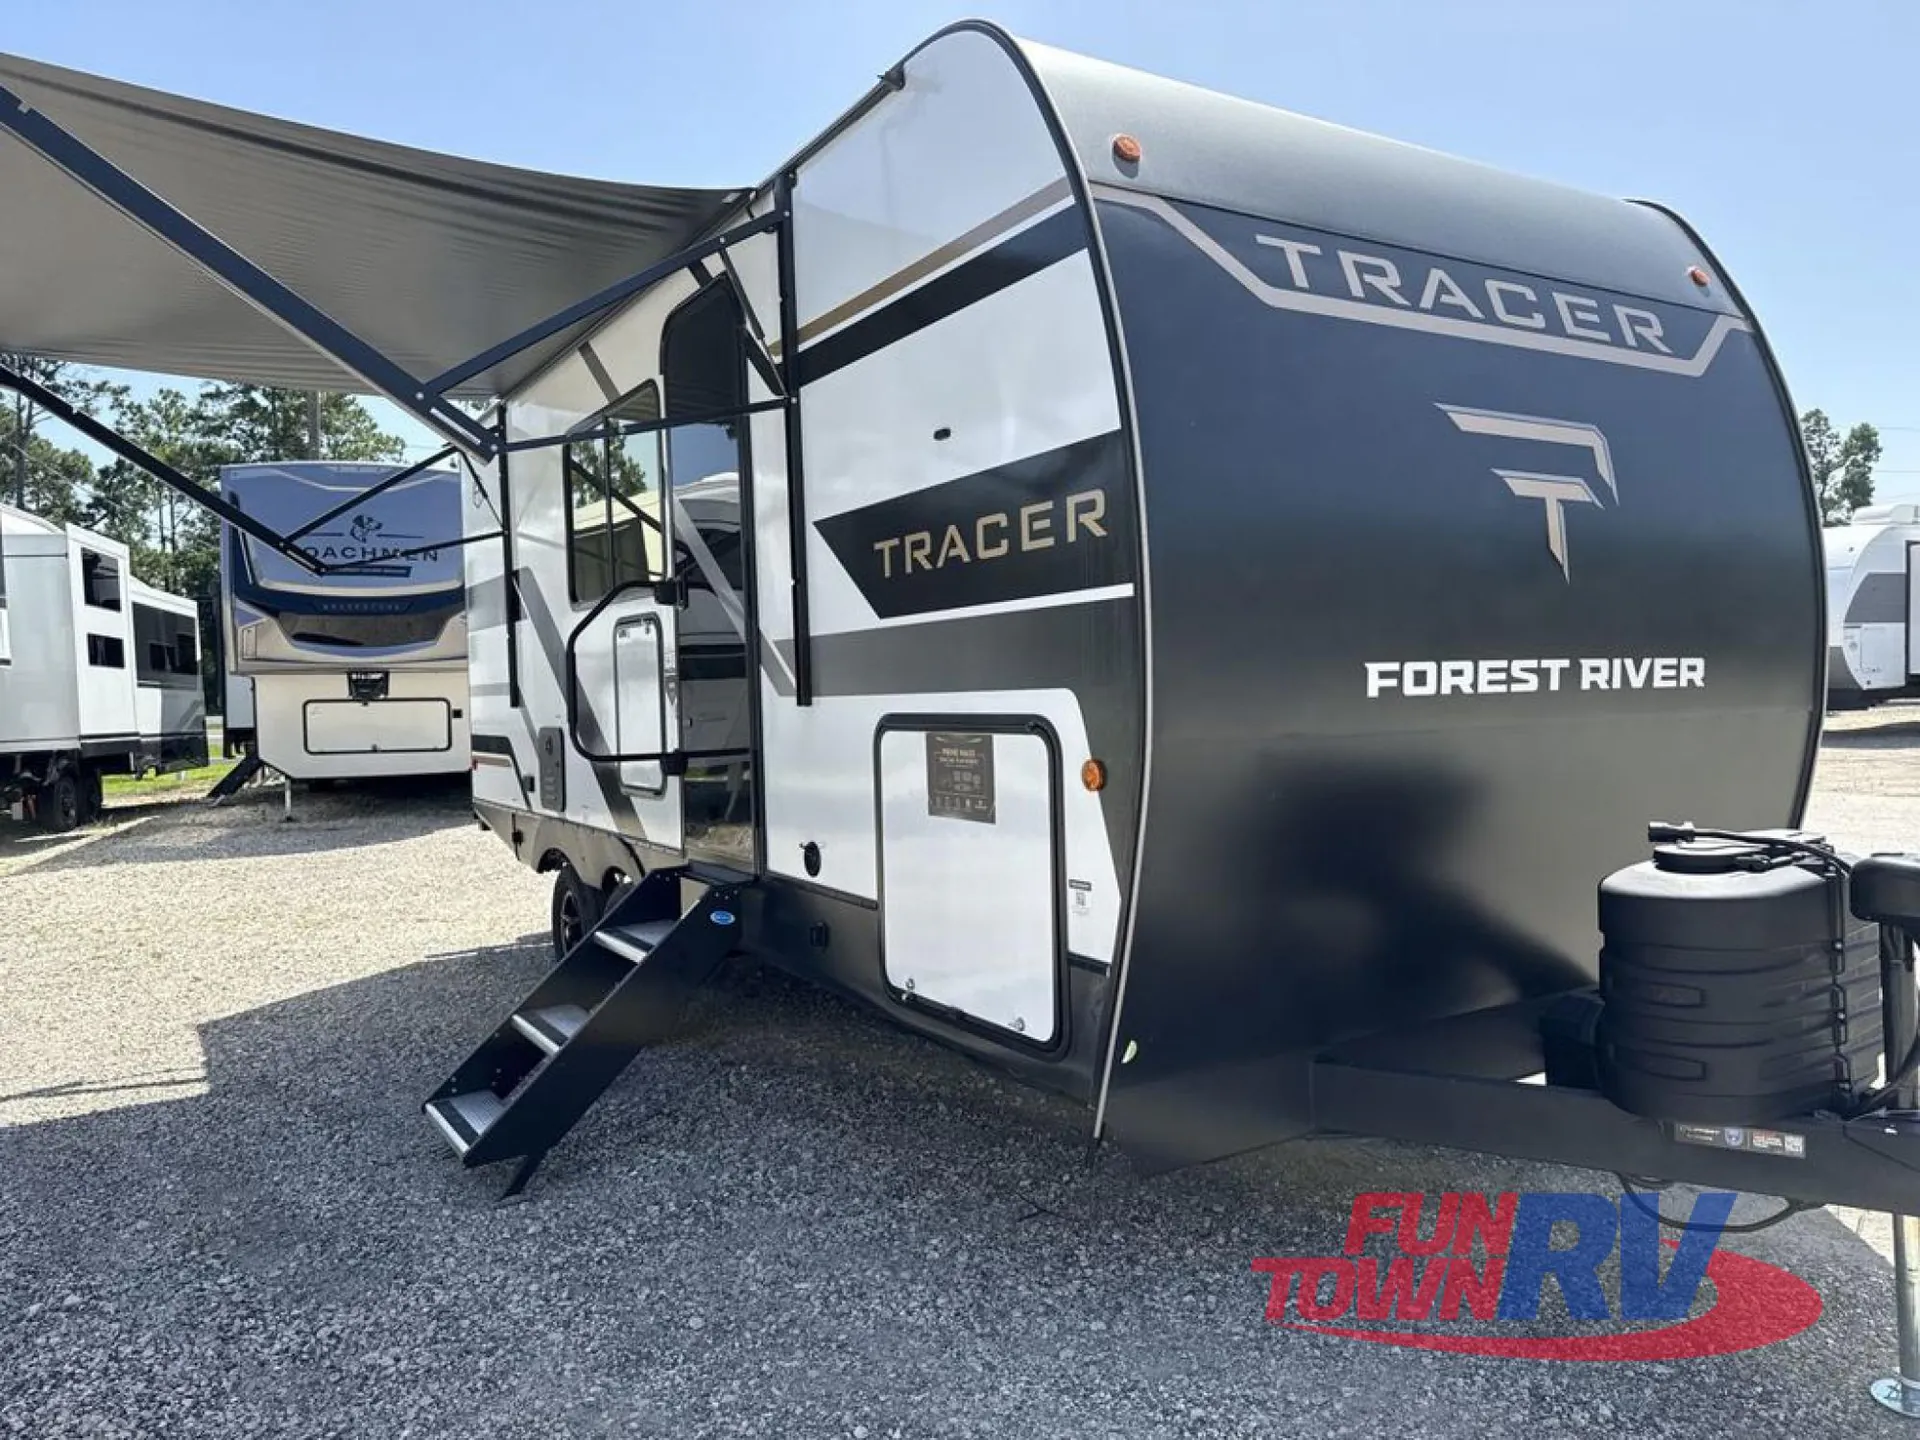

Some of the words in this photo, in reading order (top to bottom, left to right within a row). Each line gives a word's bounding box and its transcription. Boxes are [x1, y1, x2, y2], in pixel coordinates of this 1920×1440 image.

[1255, 234, 1673, 354] TRACER
[287, 546, 438, 562] OACHMEN
[873, 488, 1108, 578] TRACER
[1365, 659, 1570, 698] FOREST
[1579, 657, 1705, 691] RIVER
